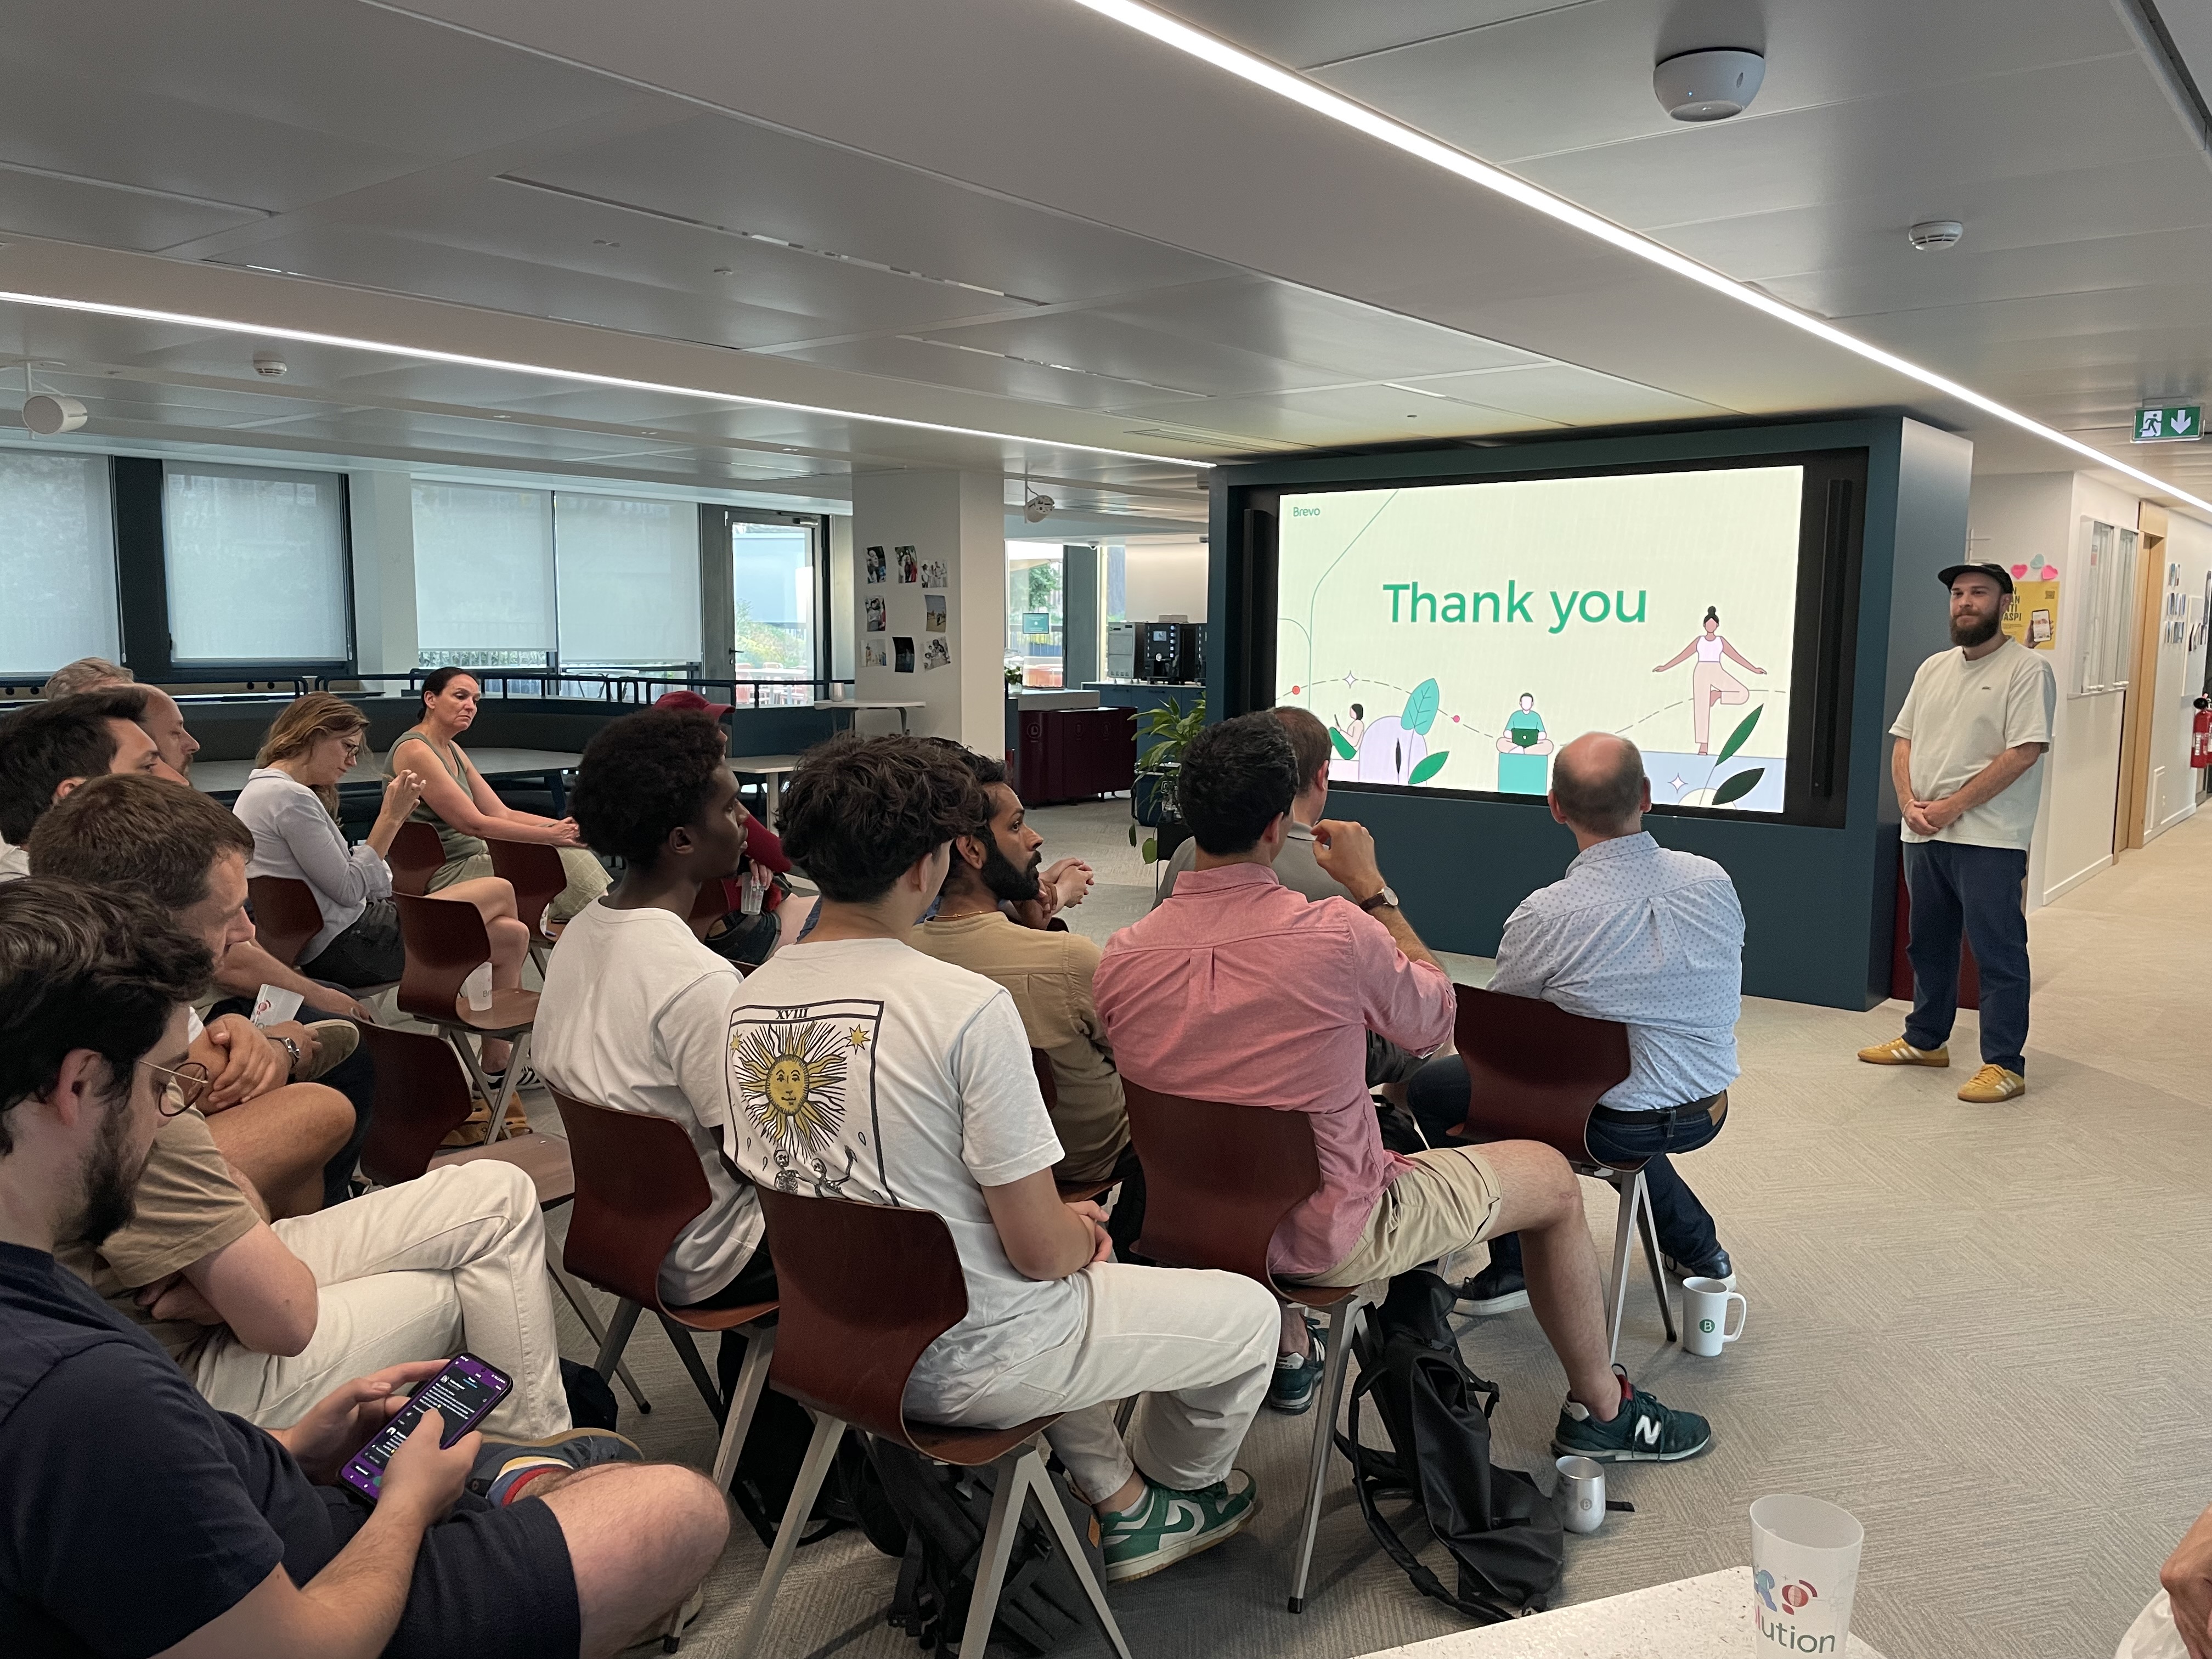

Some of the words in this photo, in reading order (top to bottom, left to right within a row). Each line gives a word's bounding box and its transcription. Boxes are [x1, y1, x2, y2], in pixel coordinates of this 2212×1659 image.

[1293, 506, 1321, 517] Brevo
[1383, 579, 1534, 623] Thank
[1548, 590, 1647, 634] you
[2004, 612, 2022, 621] ASPI
[775, 1008, 809, 1020] XVIII
[1634, 1414, 1662, 1445] N
